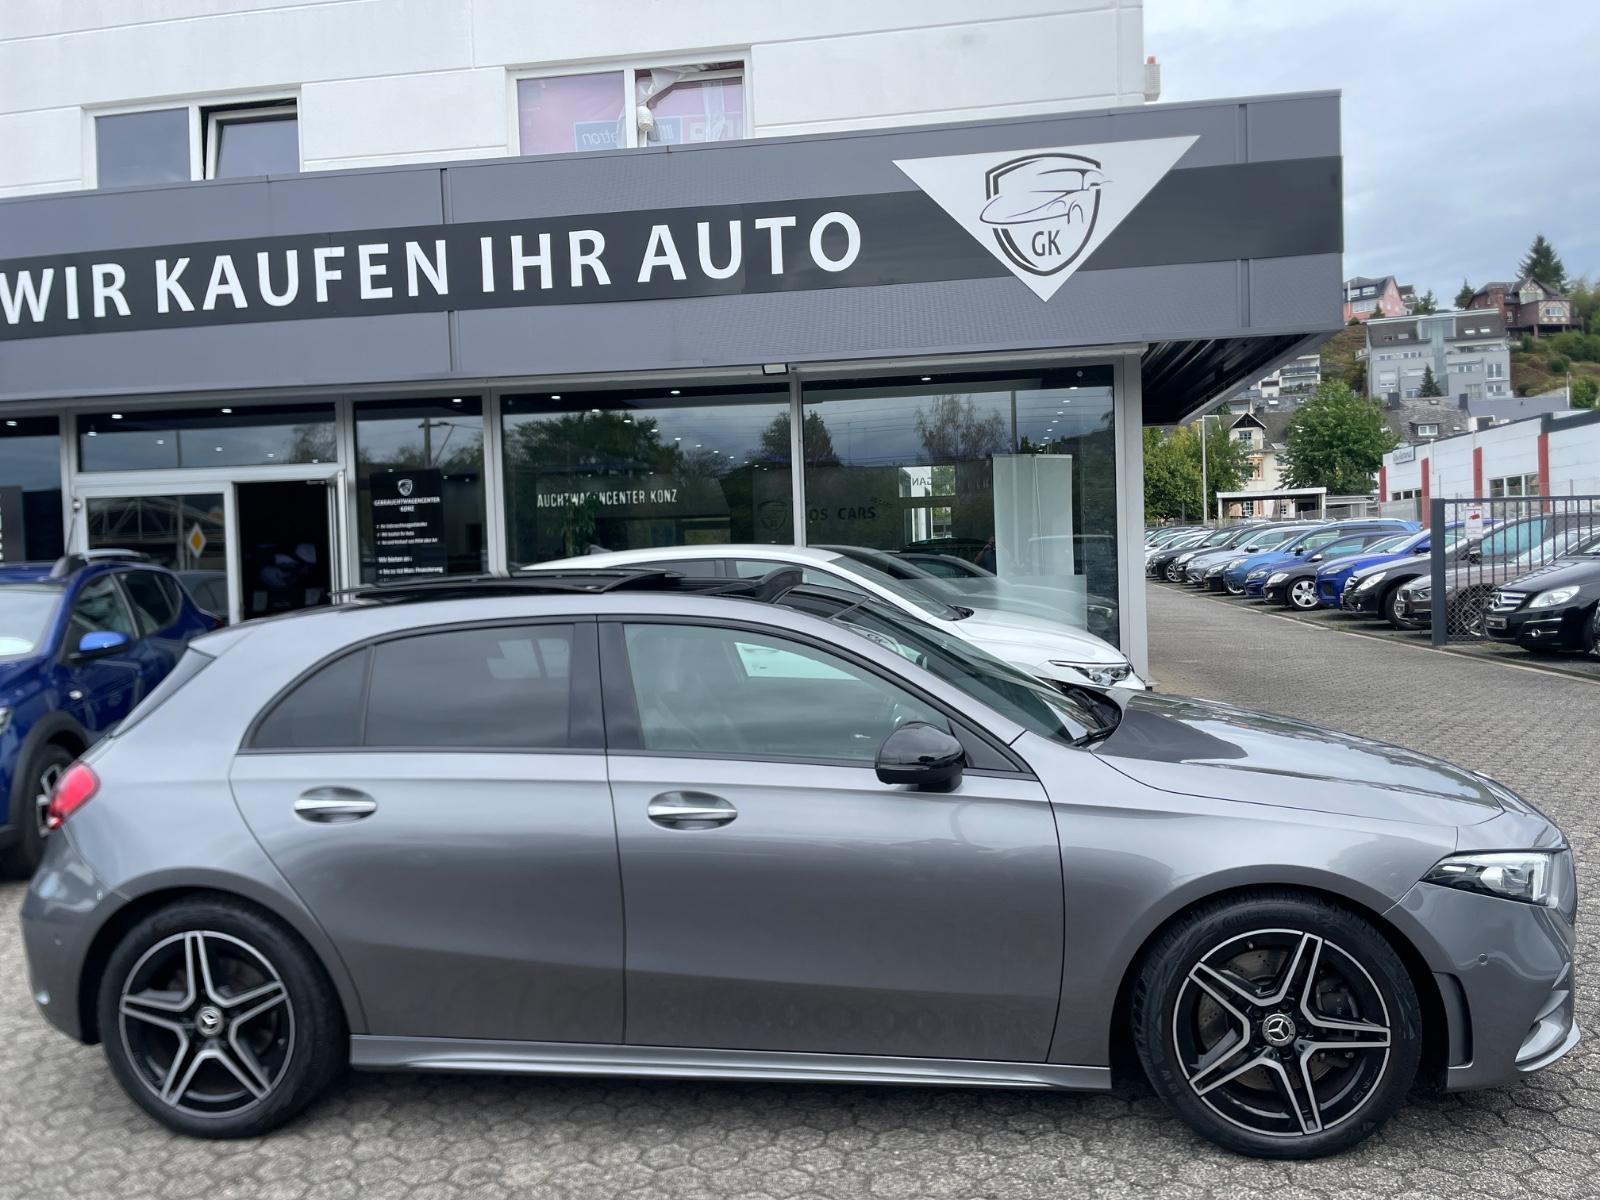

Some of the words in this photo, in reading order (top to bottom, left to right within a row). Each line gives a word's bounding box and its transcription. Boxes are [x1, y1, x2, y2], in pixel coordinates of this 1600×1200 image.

[1031, 229, 1062, 257] GK
[0, 263, 131, 325] WIR
[155, 239, 449, 314] KAUFEN
[480, 229, 611, 293] IHR
[637, 211, 861, 283] AUTO
[650, 489, 678, 503] KONZ
[838, 506, 876, 520] CARS
